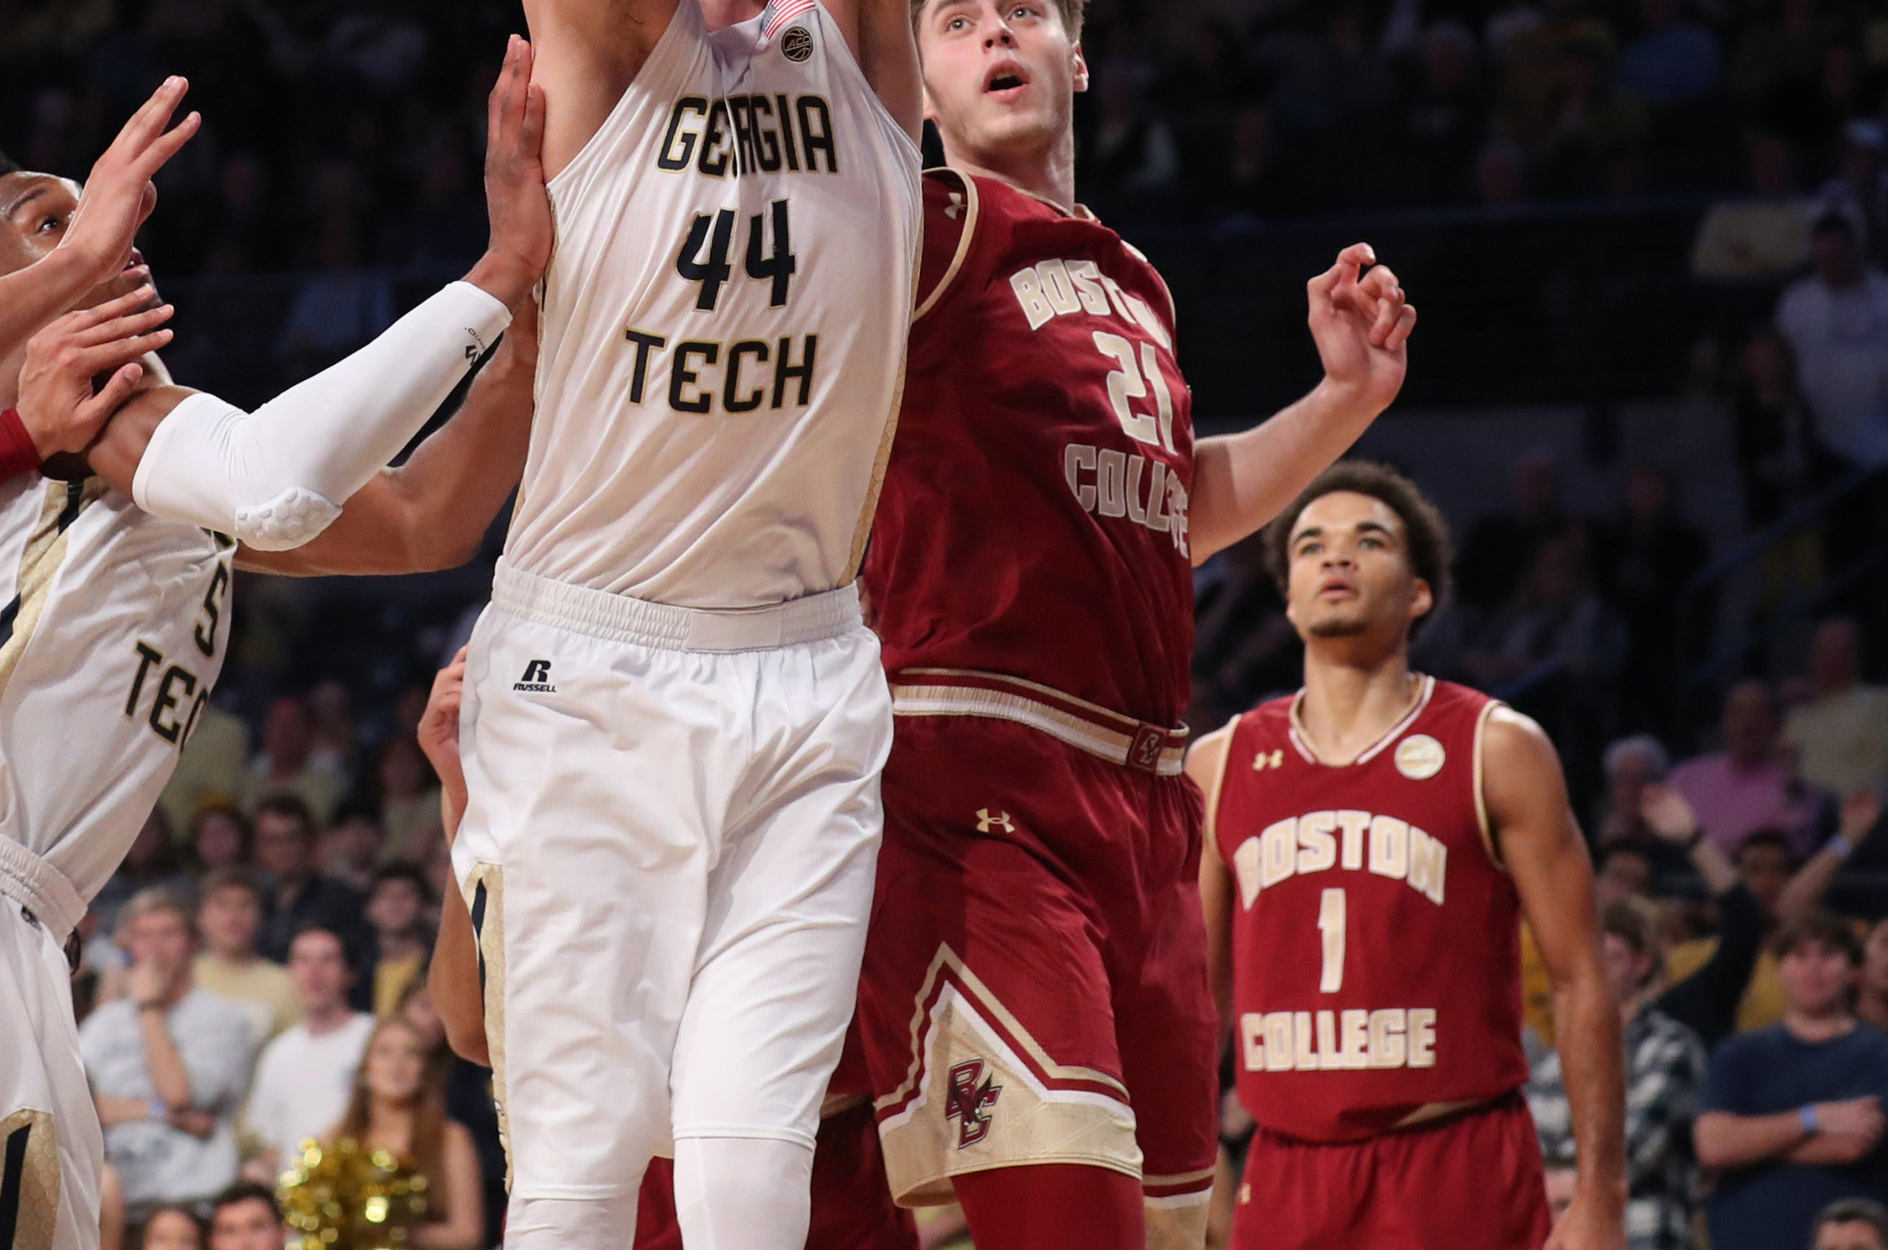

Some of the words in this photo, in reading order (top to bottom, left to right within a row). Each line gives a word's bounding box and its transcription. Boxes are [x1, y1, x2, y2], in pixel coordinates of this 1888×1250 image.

[676, 198, 796, 312] 44
[624, 327, 818, 415] TECH
[1091, 329, 1178, 457] 21
[512, 682, 557, 693] RUSSELL
[520, 658, 552, 683] R
[1233, 809, 1448, 911] BOSTON
[1317, 887, 1346, 994] 1
[1240, 1007, 1437, 1072] COLLEGE
